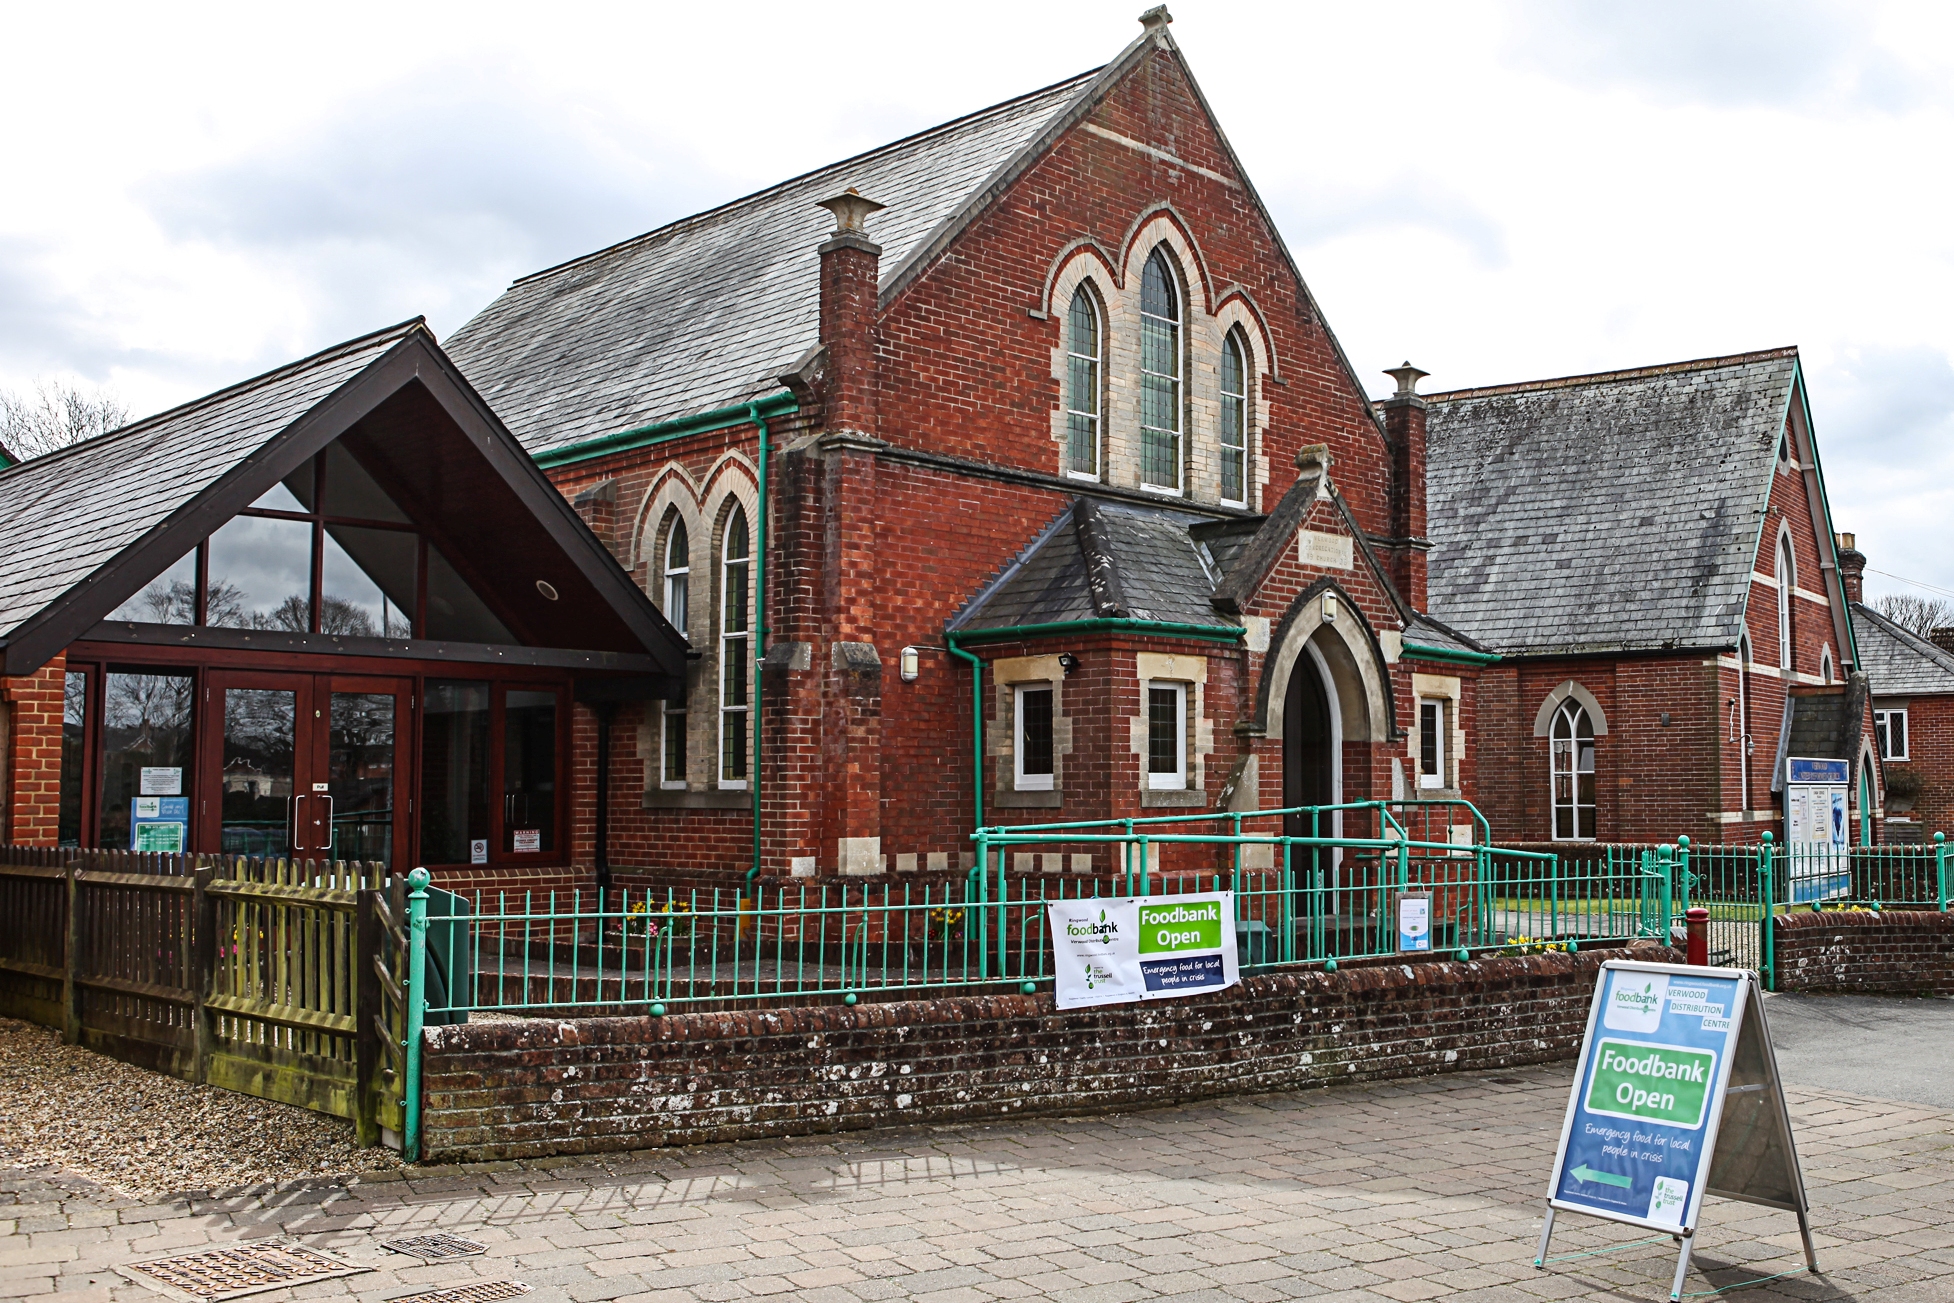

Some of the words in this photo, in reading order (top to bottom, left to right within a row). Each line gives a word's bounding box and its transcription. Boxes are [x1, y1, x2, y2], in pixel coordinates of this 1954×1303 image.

[1141, 905, 1218, 925] Foodbank
[1067, 922, 1118, 936] foodbank
[1157, 930, 1201, 949] Open
[1142, 965, 1178, 976] Emergency
[1179, 962, 1194, 971] food
[1194, 961, 1204, 969] for
[1205, 959, 1220, 968] local
[1161, 975, 1180, 986] people
[1189, 973, 1205, 981] crisis
[1615, 990, 1658, 1005] foodbank
[1668, 989, 1706, 999] VERWOOD
[1671, 1002, 1722, 1014] DISTRIBUTION
[1602, 1049, 1705, 1083] Foodbank
[1616, 1082, 1675, 1111] Open
[1585, 1122, 1631, 1144] Emergency
[1632, 1130, 1653, 1144] food
[1654, 1133, 1668, 1146] for
[1669, 1136, 1690, 1151] local
[1601, 1144, 1628, 1159] people
[1630, 1148, 1638, 1158] in
[1641, 1151, 1663, 1163] crisis
[1664, 1193, 1683, 1202] trussell
[1665, 1186, 1675, 1194] the
